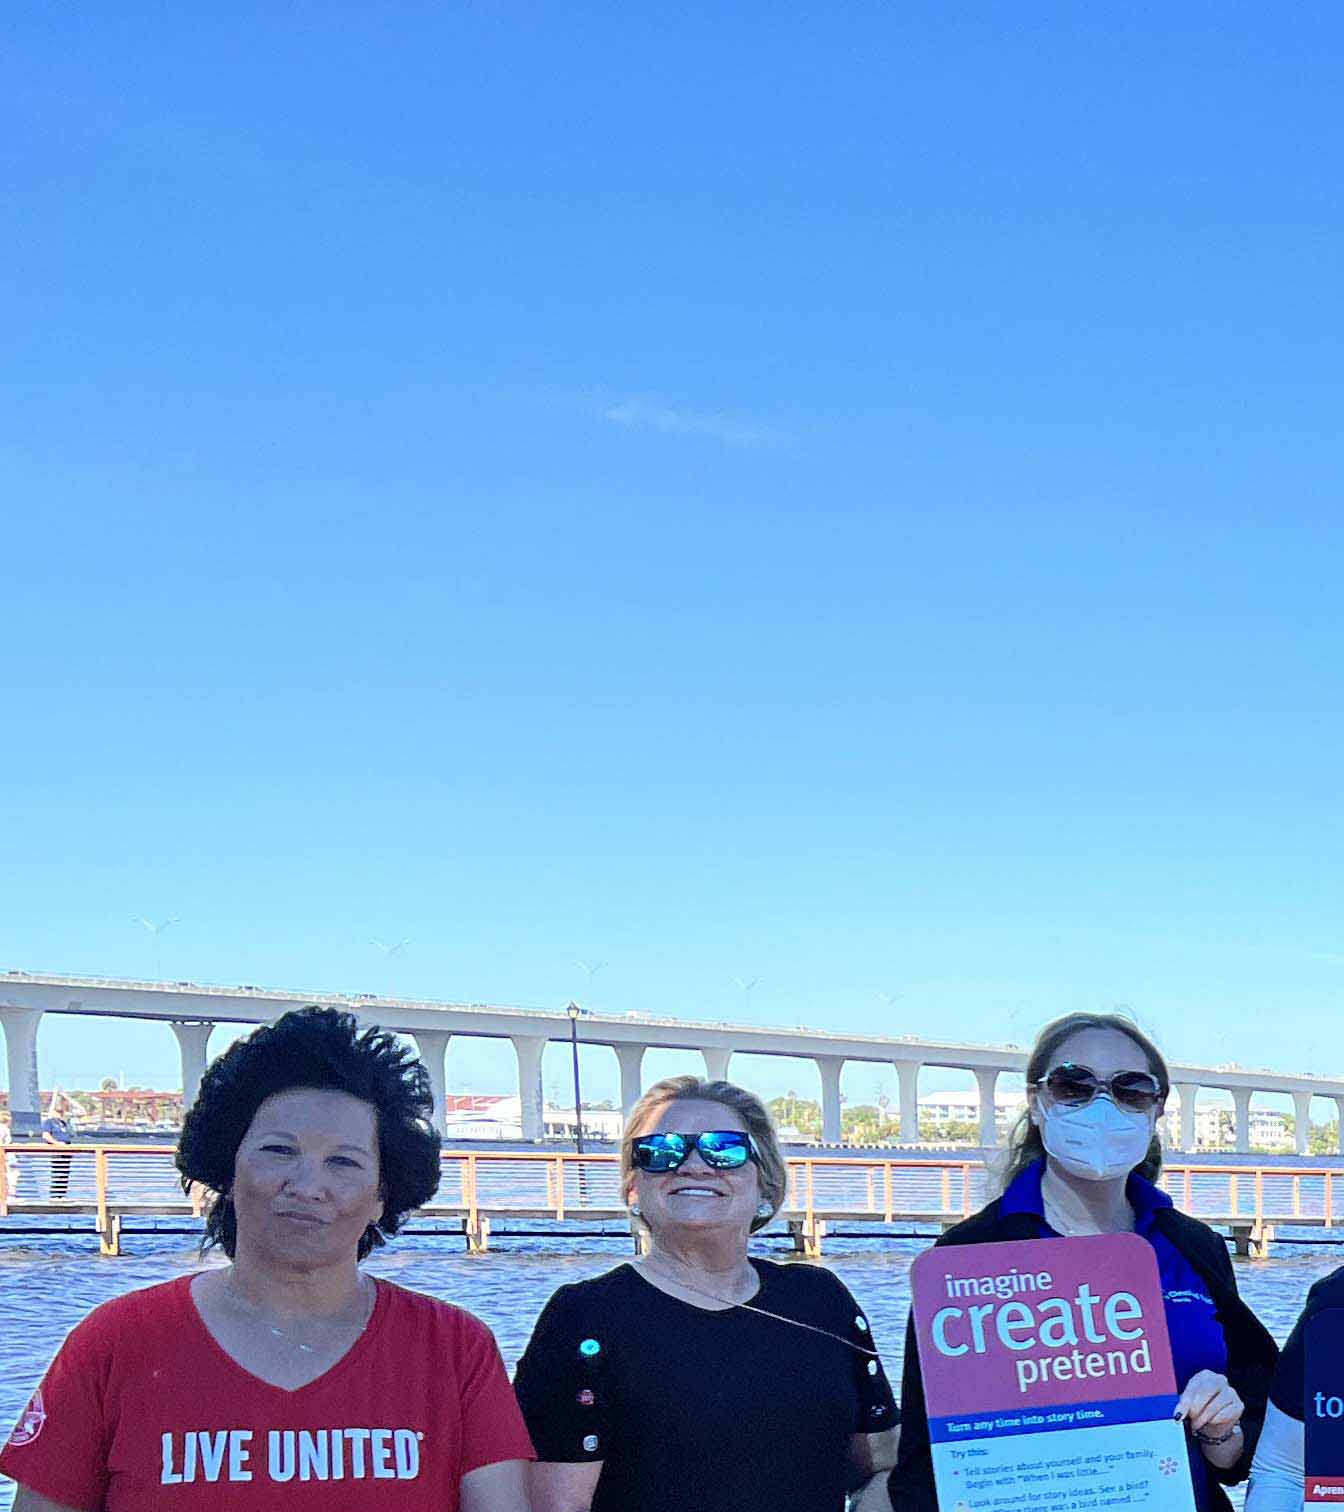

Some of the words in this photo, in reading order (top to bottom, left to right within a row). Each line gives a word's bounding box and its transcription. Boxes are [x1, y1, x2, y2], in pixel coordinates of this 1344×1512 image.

[945, 1268, 1053, 1299] imagine
[931, 1282, 1144, 1357] create
[1015, 1339, 1152, 1393] pretend
[946, 1422, 972, 1433] Turn
[973, 1419, 994, 1433] any
[995, 1416, 1021, 1428] time
[1023, 1414, 1045, 1426] into
[1046, 1410, 1075, 1426] story
[1076, 1408, 1105, 1420] time.
[161, 1430, 253, 1484] LIVE
[268, 1428, 420, 1482] UNITED
[949, 1450, 965, 1459] Try
[1085, 1455, 1102, 1464] and
